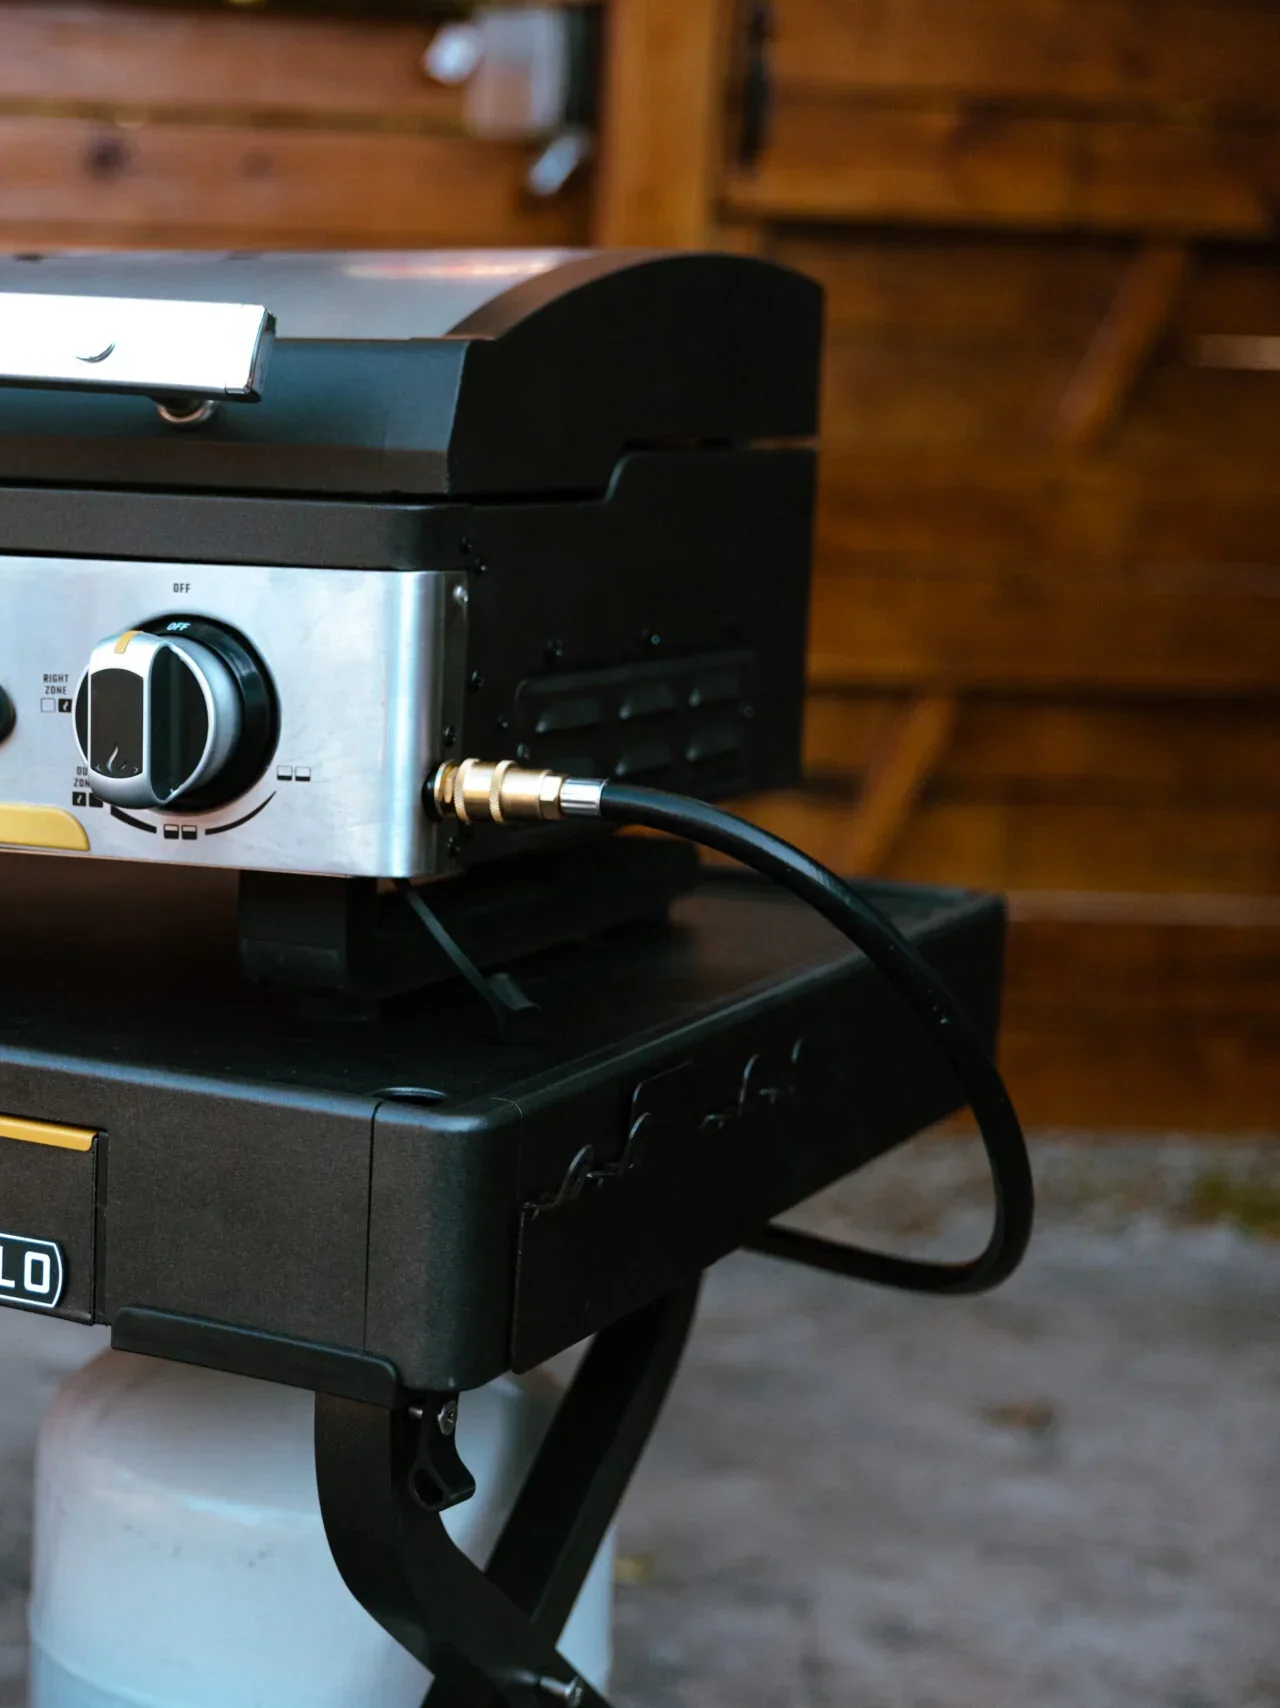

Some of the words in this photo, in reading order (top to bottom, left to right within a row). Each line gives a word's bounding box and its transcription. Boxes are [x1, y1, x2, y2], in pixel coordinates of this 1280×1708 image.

[173, 582, 191, 594] OFF
[166, 621, 191, 631] OFF
[43, 673, 69, 683] RIGHT
[44, 685, 67, 695] ZONE
[73, 778, 91, 788] ZON
